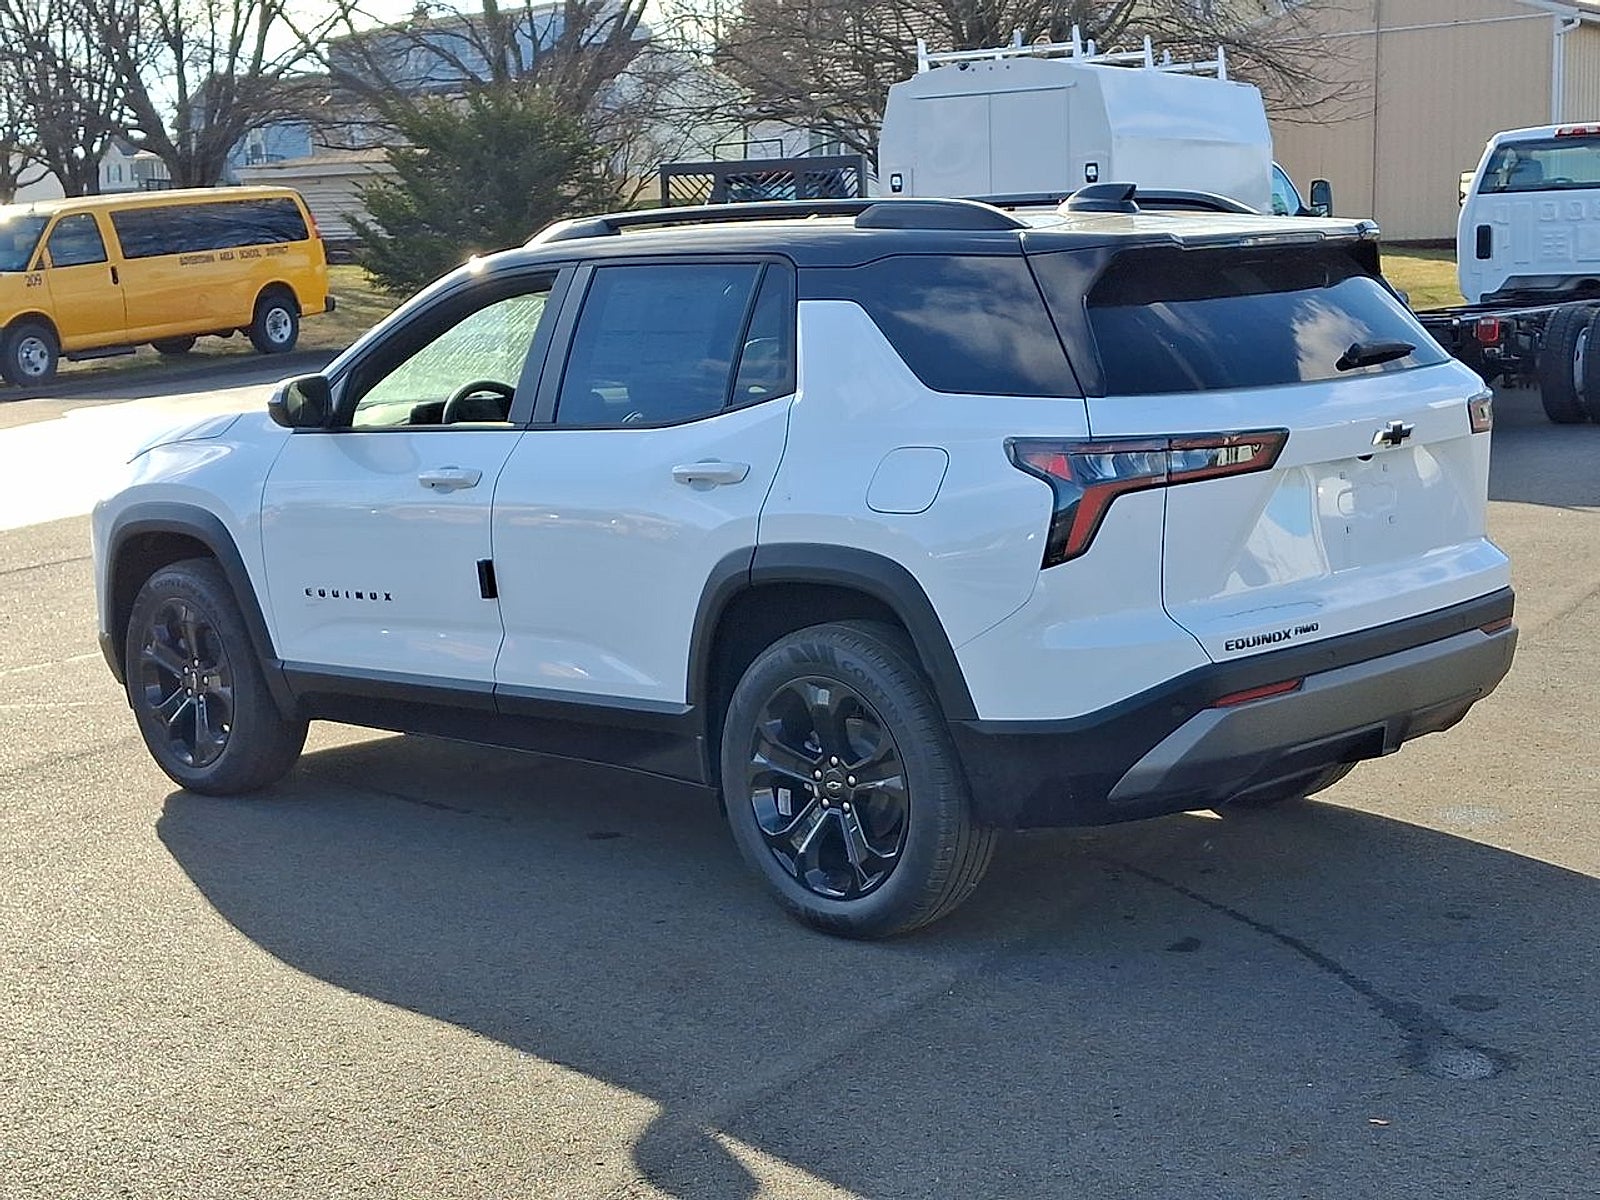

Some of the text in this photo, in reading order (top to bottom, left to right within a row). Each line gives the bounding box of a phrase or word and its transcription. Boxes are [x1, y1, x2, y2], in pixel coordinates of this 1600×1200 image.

[304, 587, 392, 601] EQUINOX
[1224, 622, 1319, 652] EQUINOX AWD
